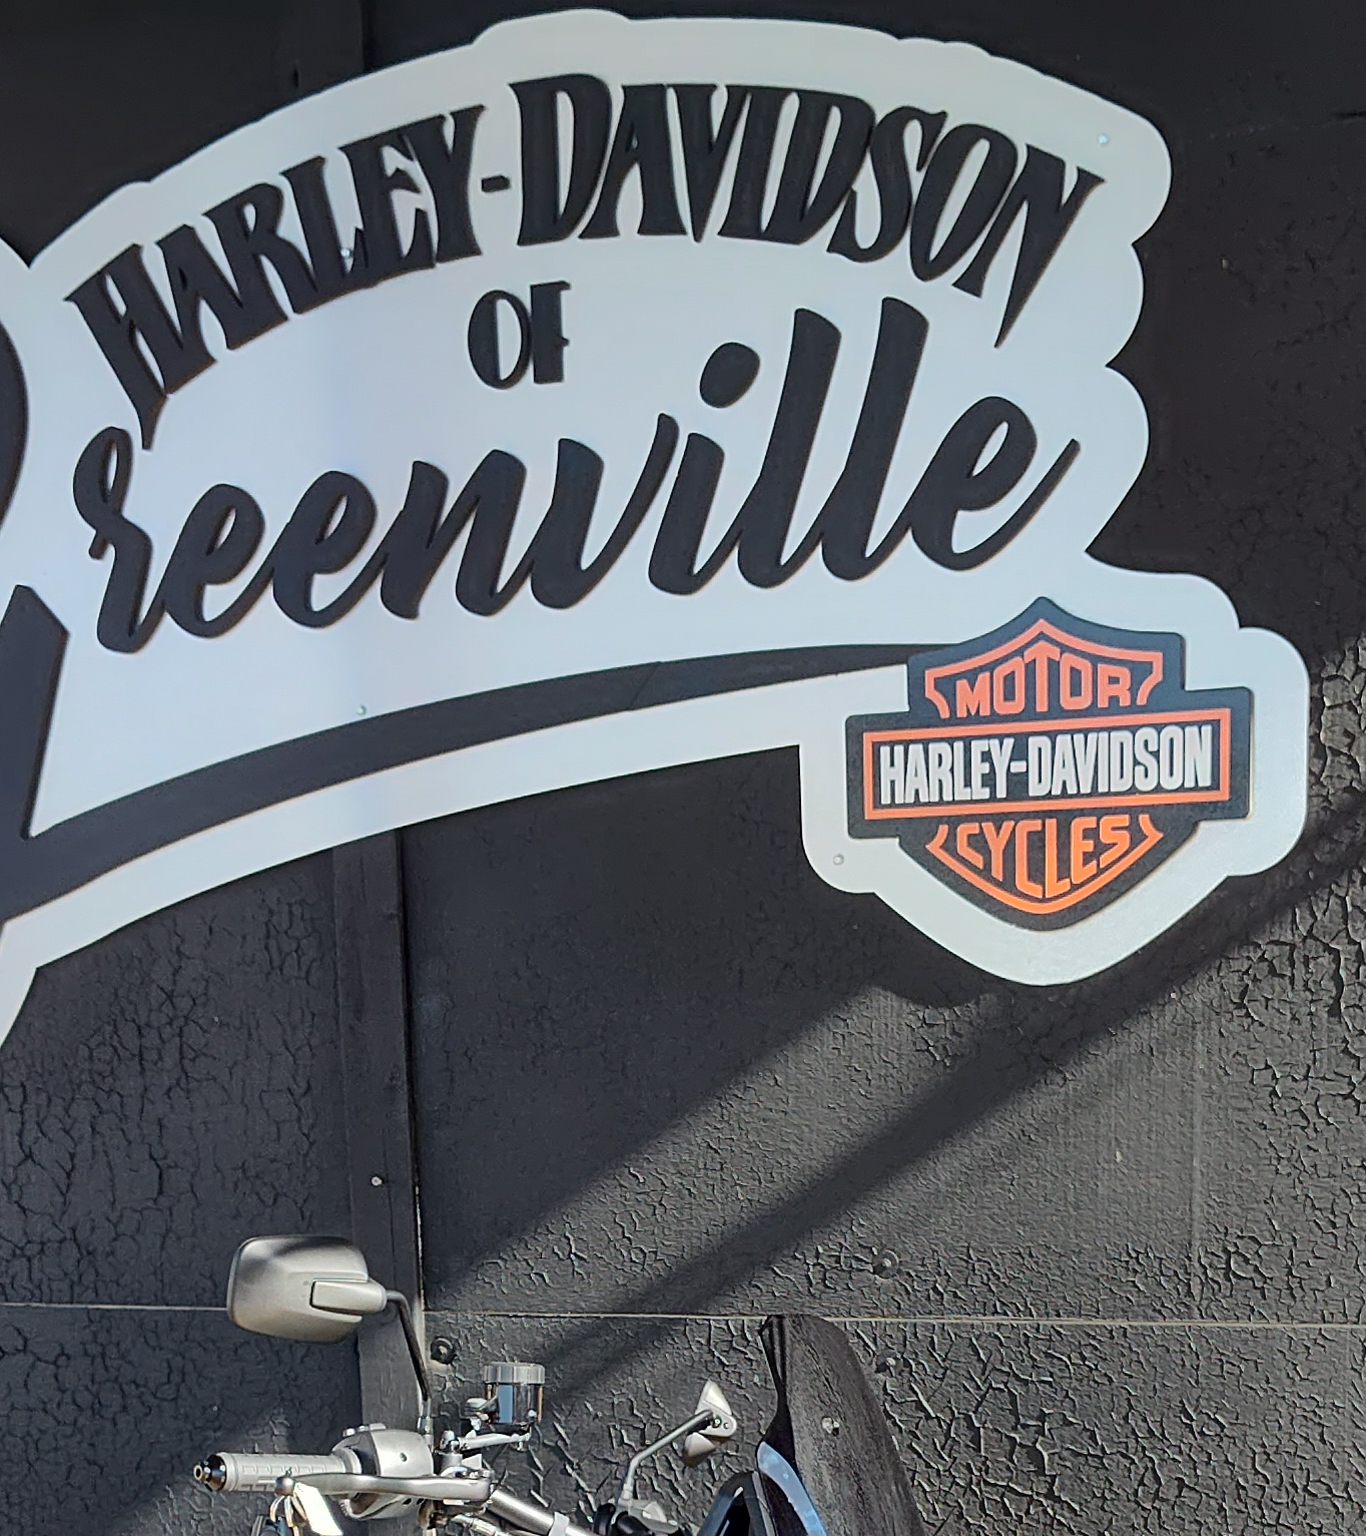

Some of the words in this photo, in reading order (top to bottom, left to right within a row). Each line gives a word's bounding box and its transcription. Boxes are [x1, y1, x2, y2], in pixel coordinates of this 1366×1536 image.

[64, 73, 1105, 450] HARLEY-DAVIDSON
[467, 280, 571, 389] OF
[955, 640, 1132, 719] MOTOR
[879, 724, 1213, 806] HARLEY-DAVIDSON
[956, 814, 1131, 899] CYCLES
